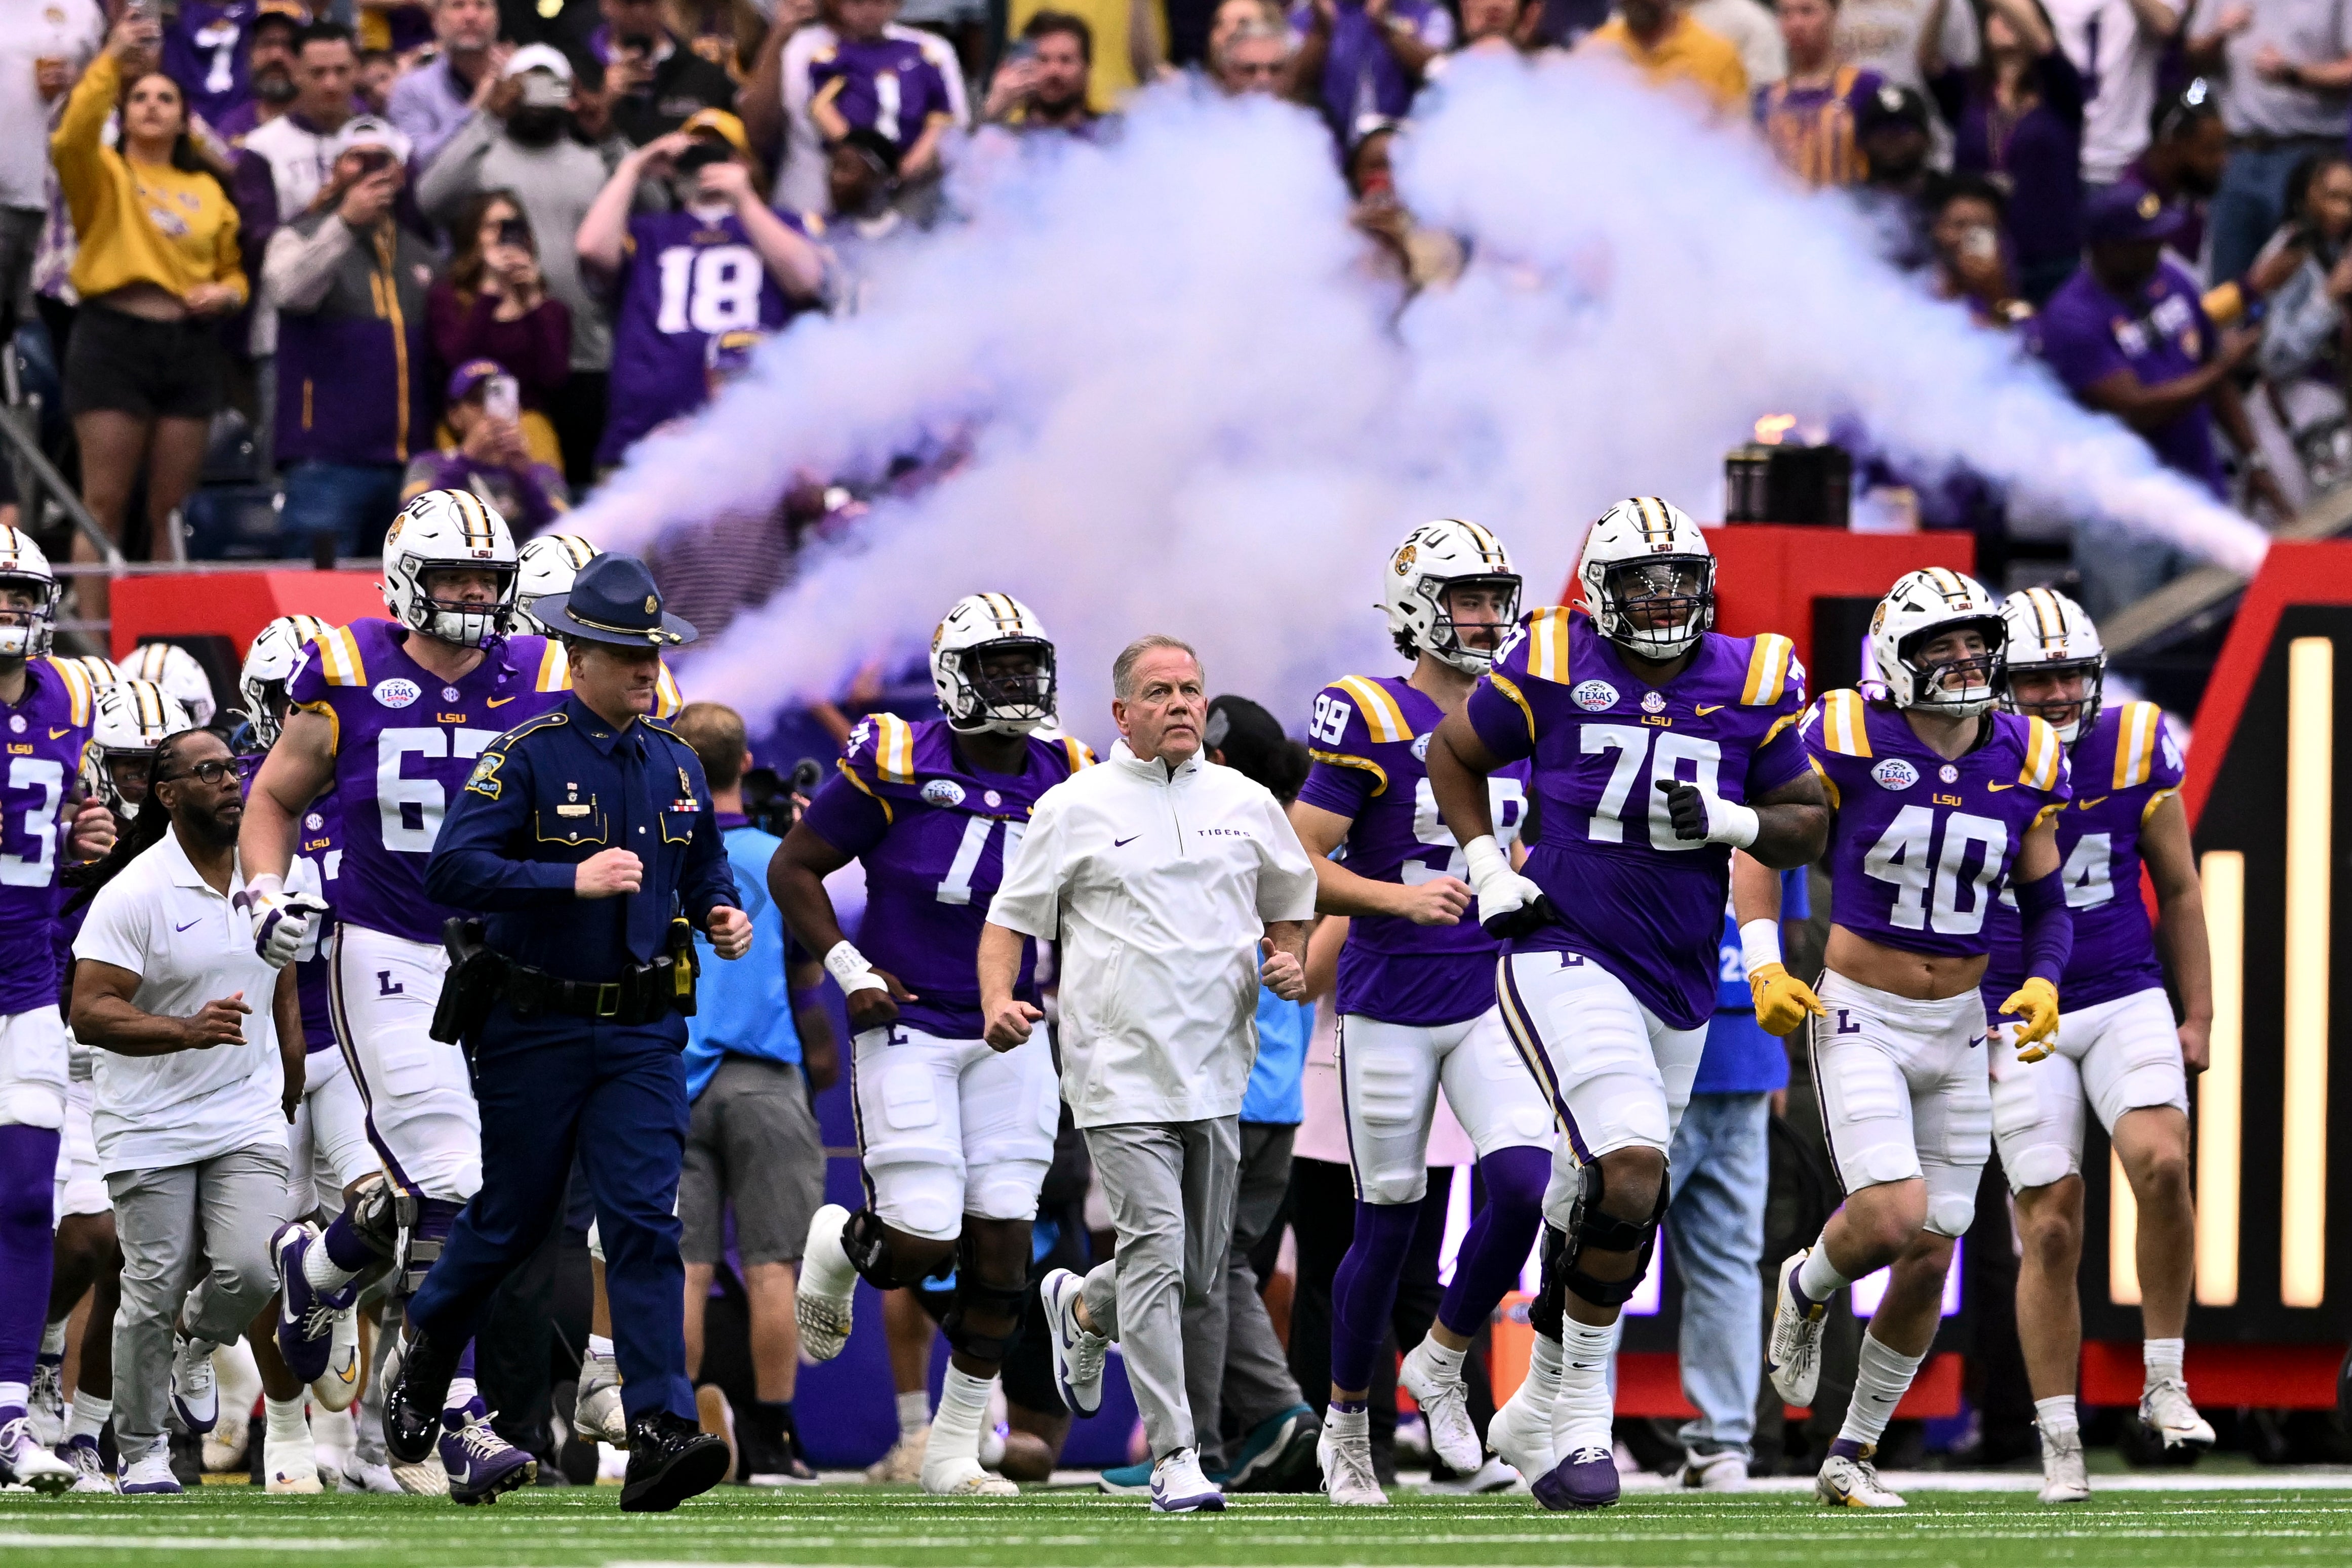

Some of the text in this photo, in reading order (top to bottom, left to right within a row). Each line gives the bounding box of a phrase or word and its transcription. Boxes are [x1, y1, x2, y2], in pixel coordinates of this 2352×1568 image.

[194, 25, 240, 93] 7
[875, 75, 900, 140] 1
[657, 245, 763, 335] 18
[471, 550, 493, 559] LSU
[1651, 544, 1673, 553] LSU
[1952, 602, 1973, 612] LSU
[2046, 650, 2067, 659] LSU
[381, 688, 414, 698] TEXAS
[443, 687, 459, 702] SEC
[1578, 691, 1612, 703] TEXAS
[1646, 692, 1662, 707] SEC
[437, 712, 466, 723] LSU
[1309, 694, 1351, 746] 99
[1641, 715, 1672, 727] LSU
[7, 744, 33, 754] LSU
[1879, 769, 1912, 782] TEXAS
[928, 789, 959, 800] TEXAS
[1580, 723, 1722, 852] 70
[1932, 793, 1962, 807] LSU
[0, 757, 64, 887] 3
[306, 814, 323, 830] SEC
[1197, 829, 1250, 837] TIGERS
[305, 837, 330, 852] LSU
[1864, 805, 2007, 935] 40
[1561, 951, 1584, 969] L
[378, 971, 403, 996] L
[1837, 1009, 1861, 1034] L
[886, 1023, 909, 1047] L
